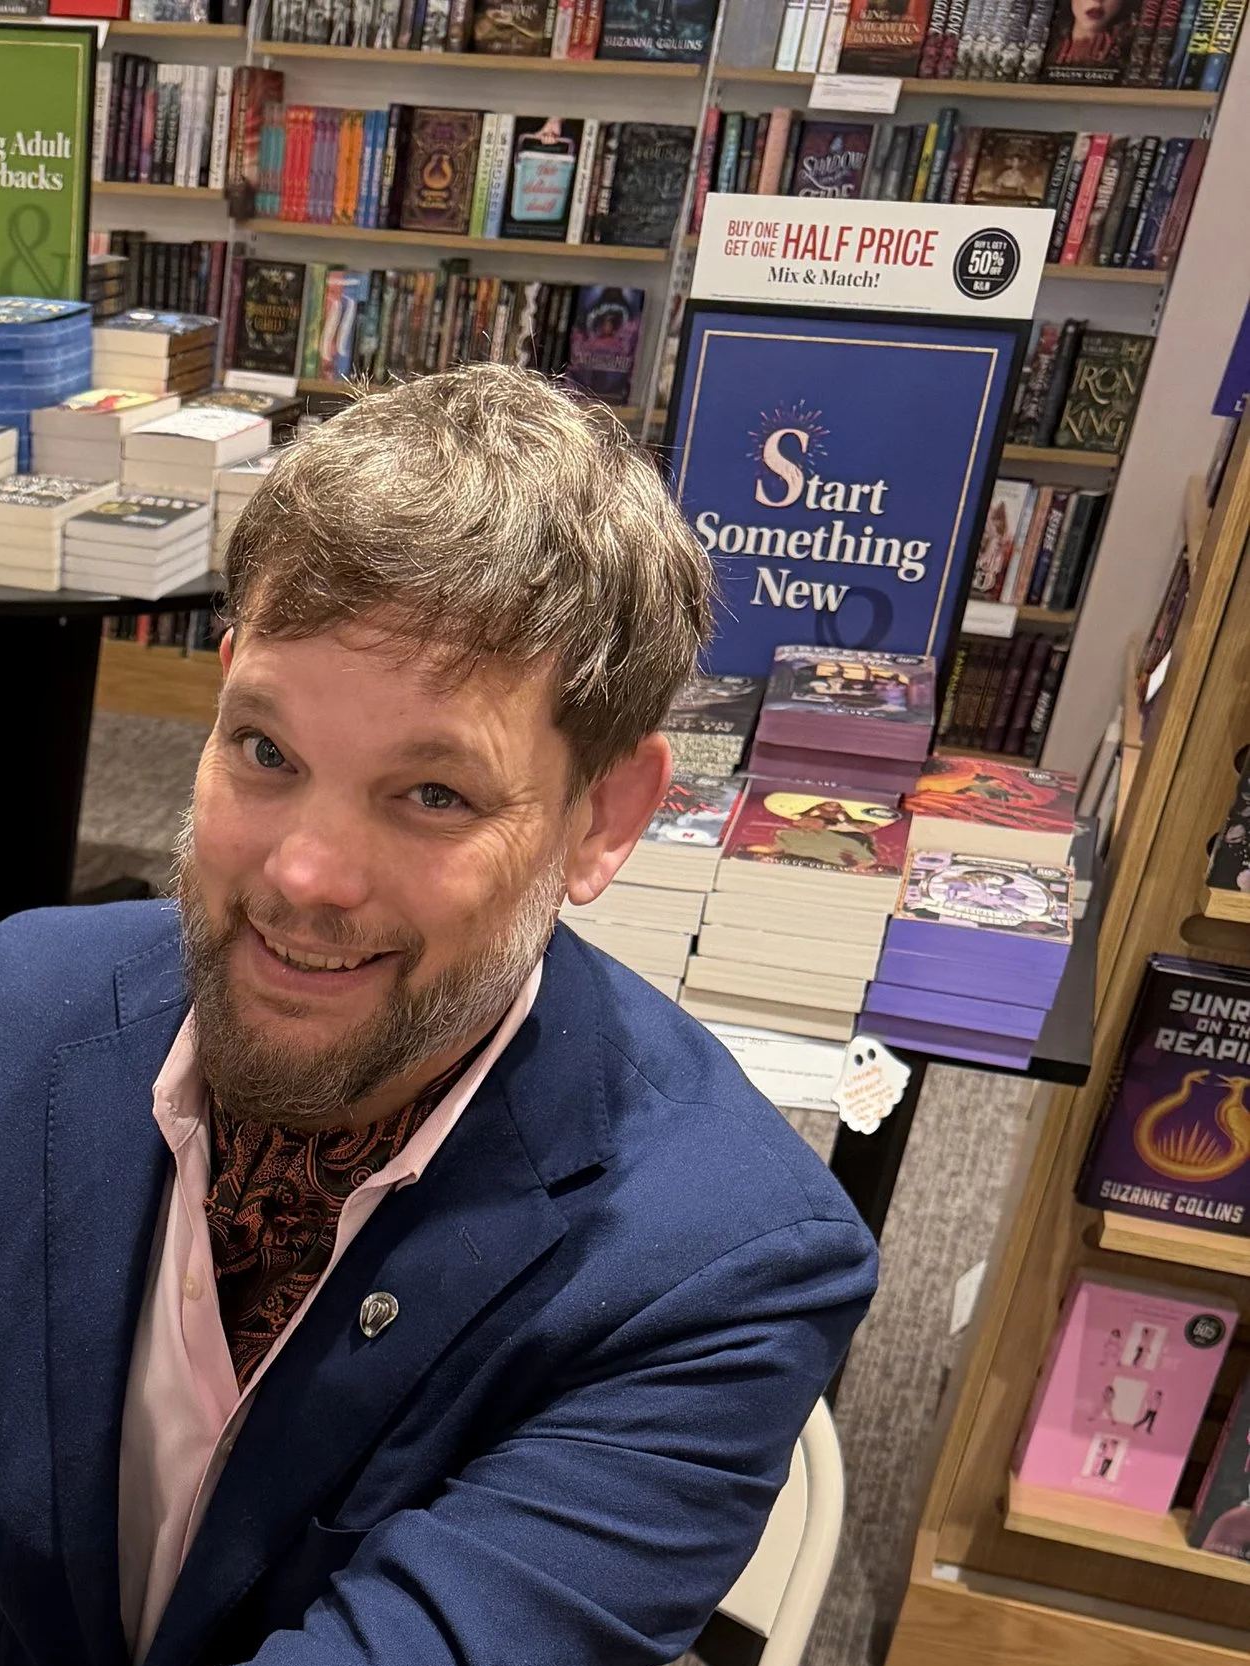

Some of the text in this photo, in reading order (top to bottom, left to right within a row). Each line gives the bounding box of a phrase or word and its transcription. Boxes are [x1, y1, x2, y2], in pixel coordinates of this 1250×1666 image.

[656, 37, 703, 51] COLLINS
[10, 131, 71, 159] Adult
[727, 219, 780, 239] BUY ONE
[781, 223, 939, 268] HALF PRICE
[724, 239, 777, 258] GET ONE
[968, 249, 1005, 275] 50%
[767, 265, 880, 289] Mix & Match!
[1059, 400, 1127, 447] KING
[753, 427, 889, 516] Start
[694, 511, 932, 583] Something
[751, 568, 849, 614] New
[1196, 1018, 1222, 1036] ON
[1154, 1028, 1250, 1067] REAPI
[1100, 1180, 1246, 1224] SUZANNE COLLINS
